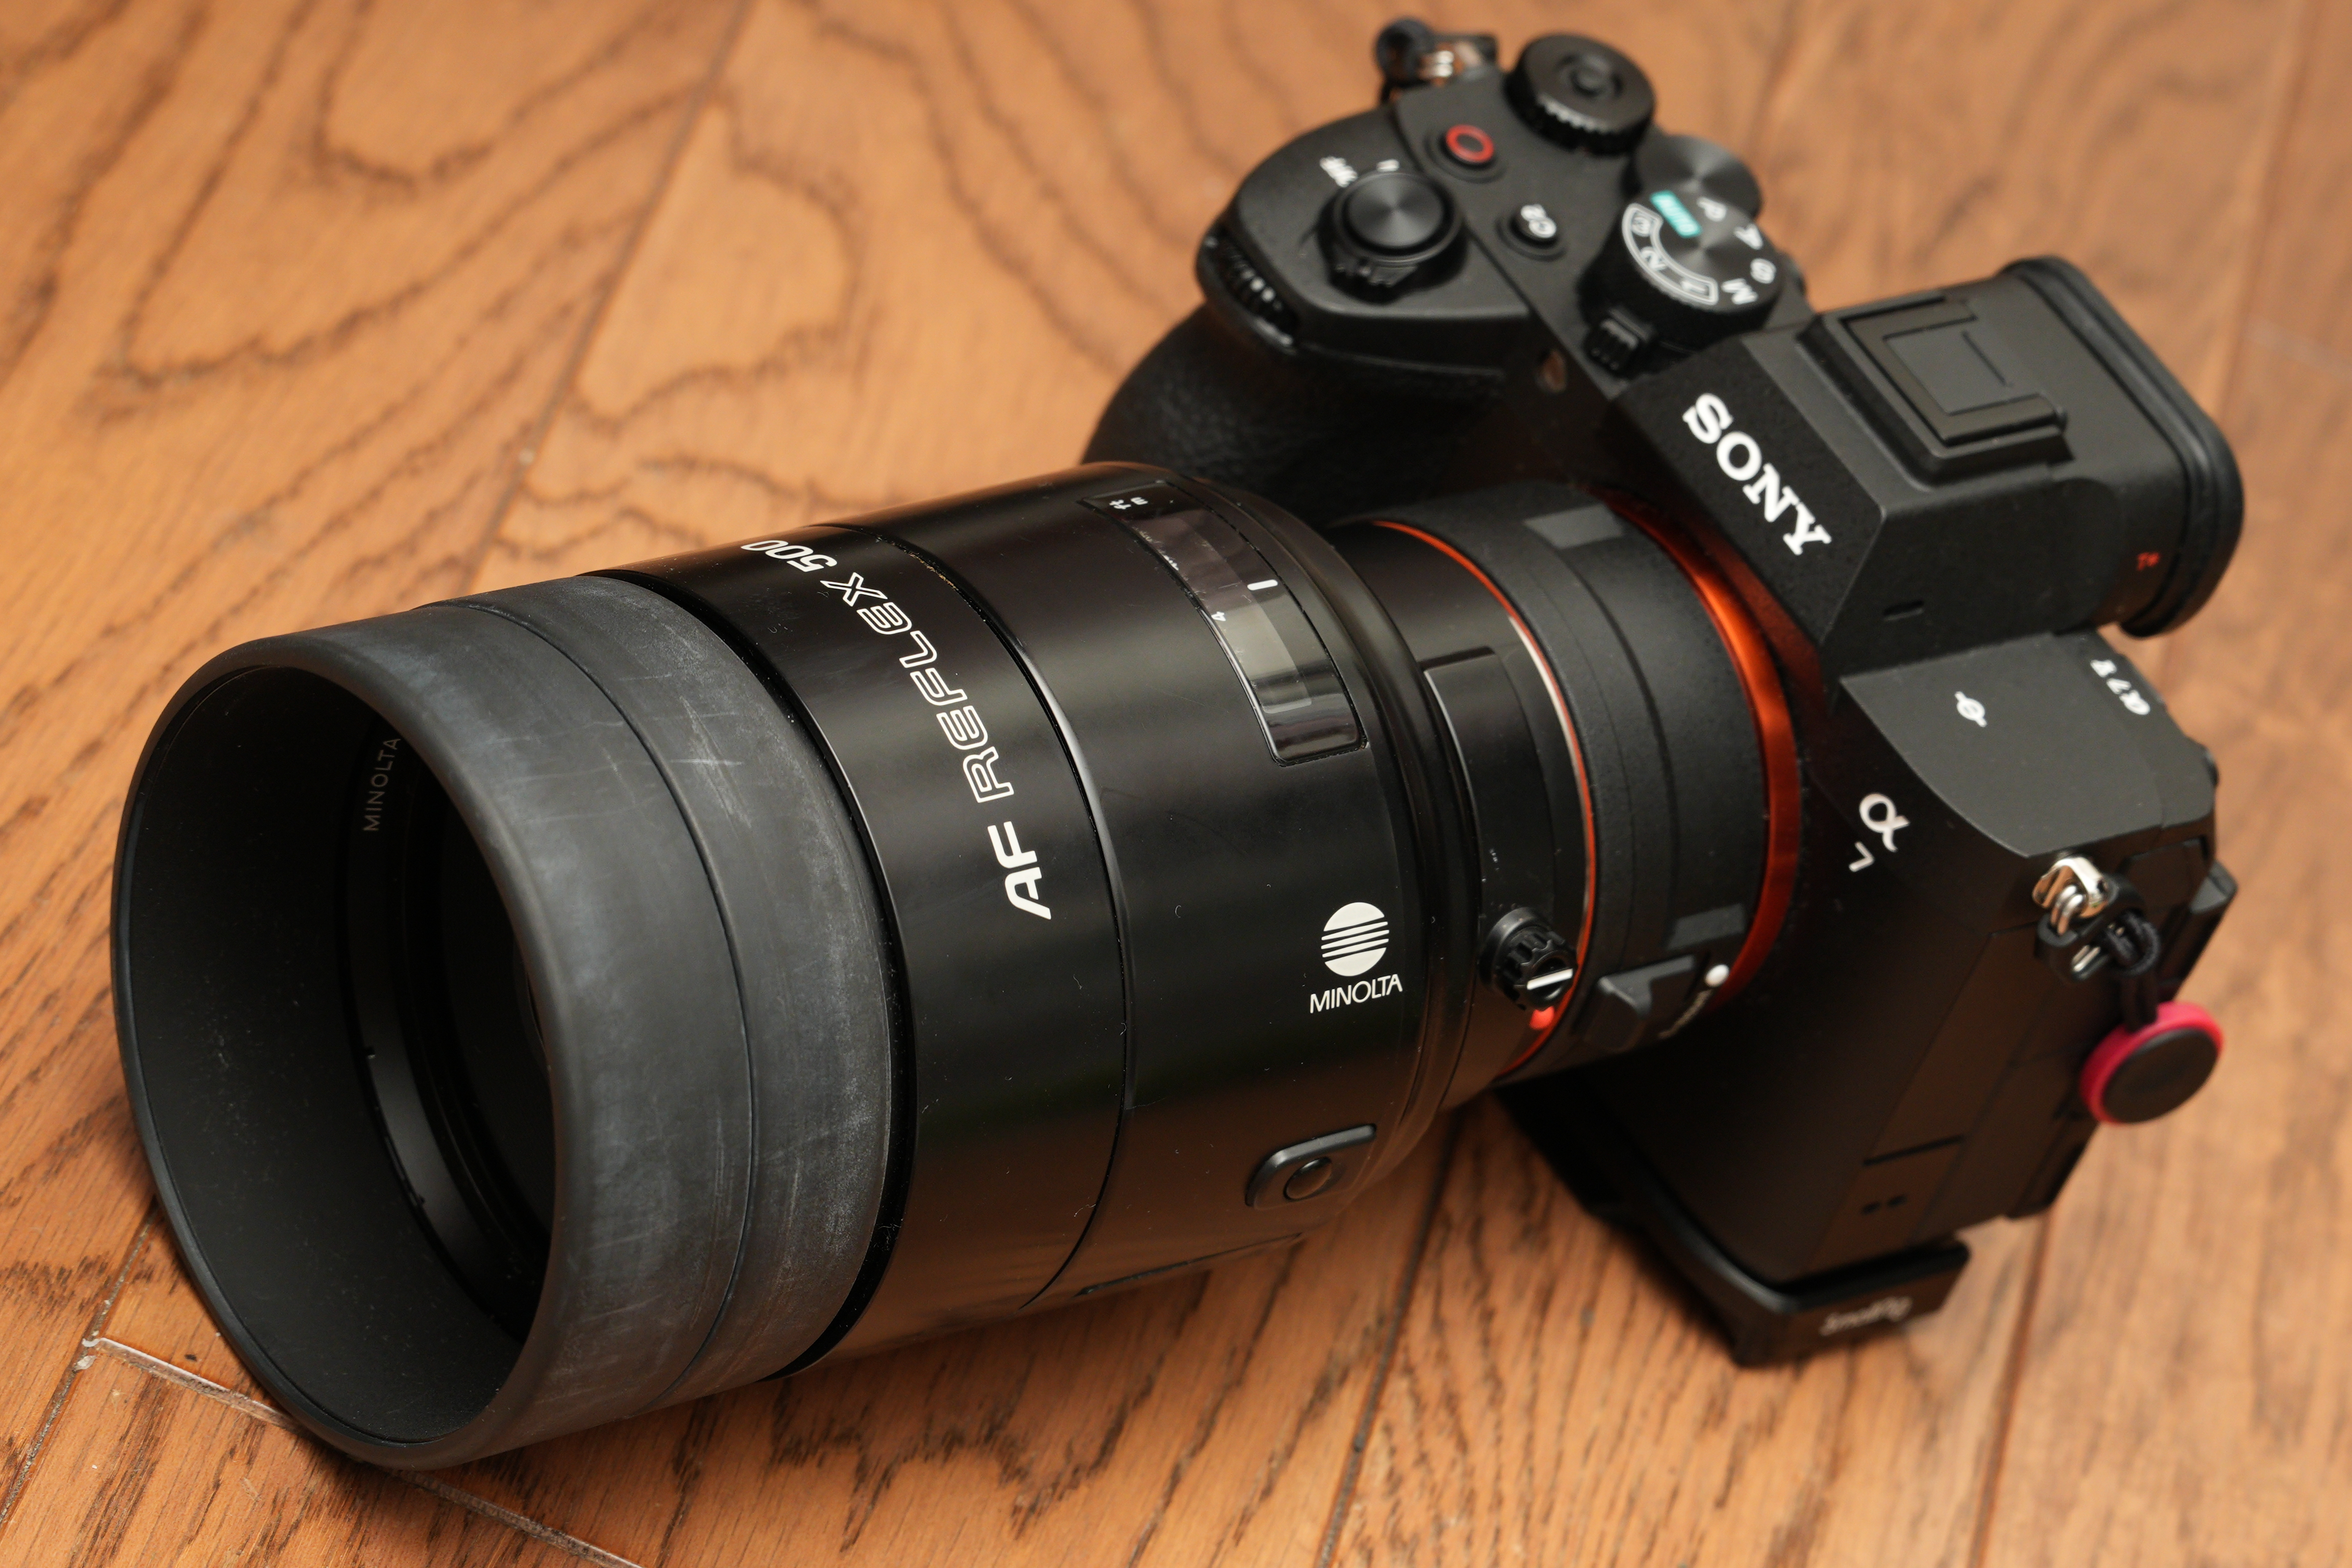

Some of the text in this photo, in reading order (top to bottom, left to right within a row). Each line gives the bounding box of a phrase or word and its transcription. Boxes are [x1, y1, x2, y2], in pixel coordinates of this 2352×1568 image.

[1683, 394, 1831, 555] SONY
[363, 738, 401, 831] MINOLTA
[740, 539, 1051, 920] AF REFLEX 500
[1310, 973, 1402, 1013] MINOLTA
